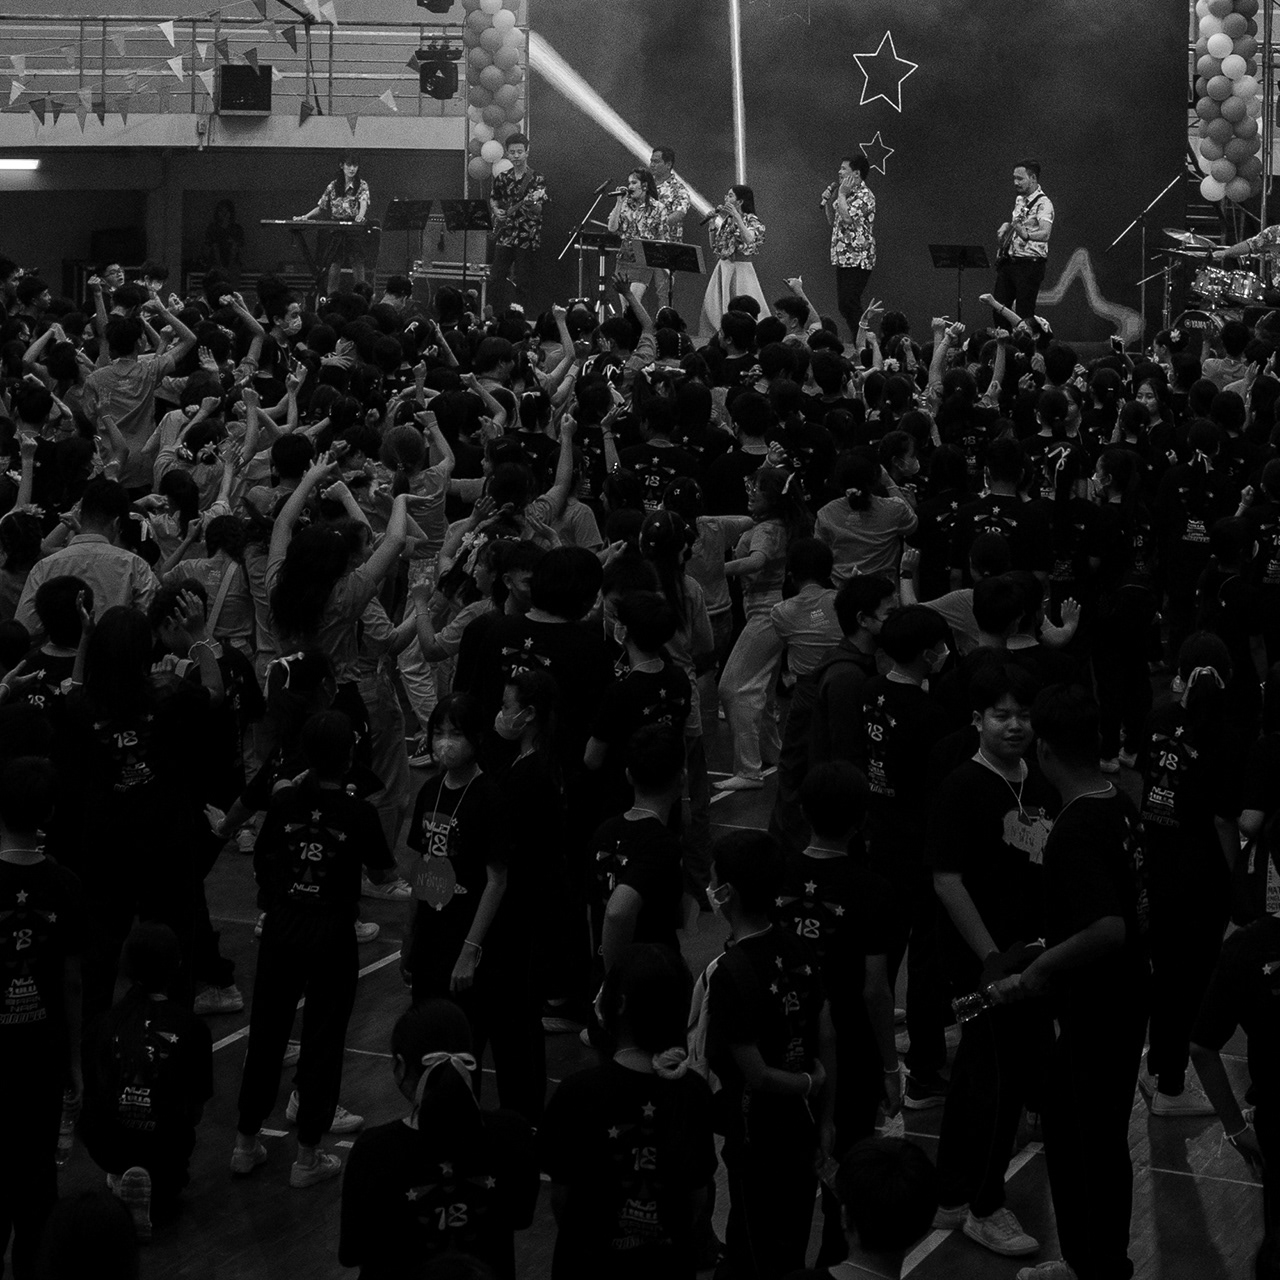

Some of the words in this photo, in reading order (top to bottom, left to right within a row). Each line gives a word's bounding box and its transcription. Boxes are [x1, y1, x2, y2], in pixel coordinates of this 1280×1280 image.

[113, 730, 138, 748] 18
[866, 722, 883, 741] 18
[1159, 750, 1178, 771] 18
[300, 841, 323, 861] 18
[794, 917, 820, 938] 18
[782, 991, 800, 1015] 18
[632, 1146, 657, 1171] 18
[434, 1203, 468, 1230] 18
